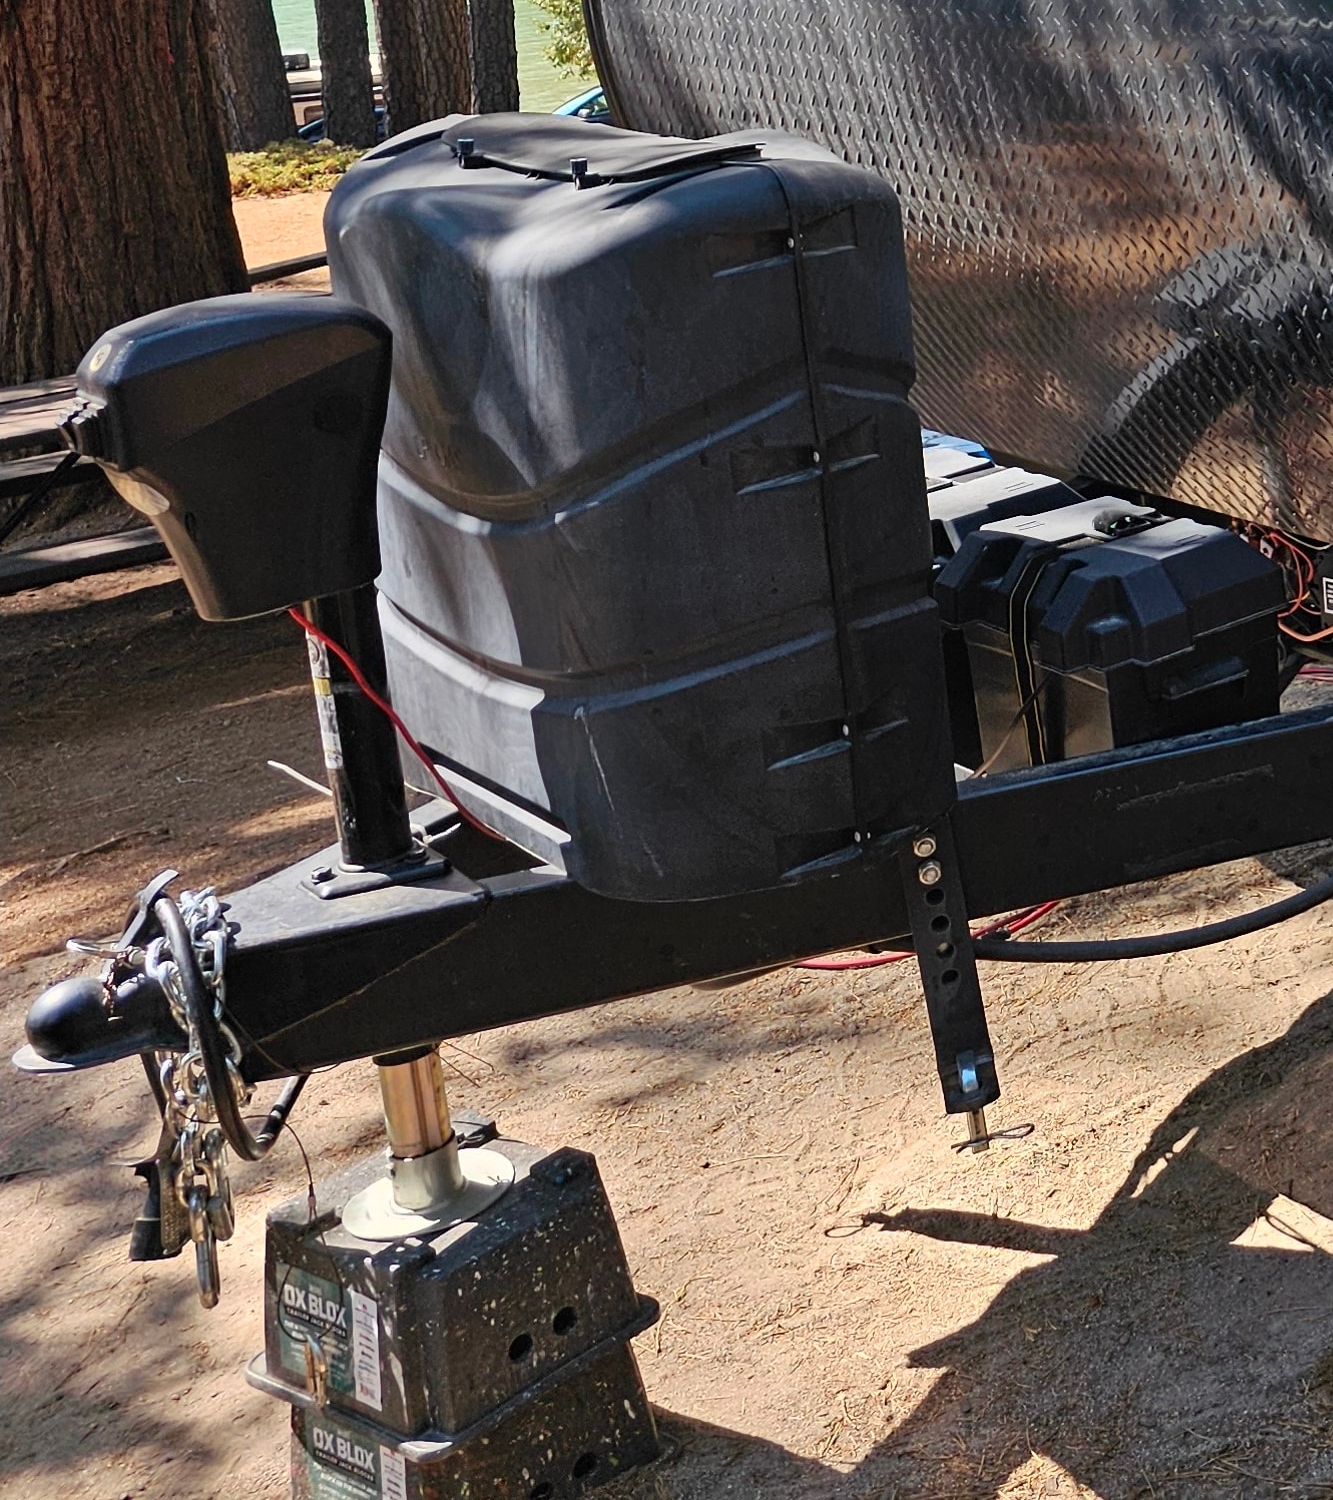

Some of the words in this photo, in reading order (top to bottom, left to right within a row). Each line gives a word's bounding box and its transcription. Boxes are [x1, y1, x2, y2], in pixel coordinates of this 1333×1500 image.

[284, 1283, 307, 1311] OX
[308, 1292, 347, 1328] BLOX
[313, 1426, 335, 1453] OX
[336, 1437, 376, 1473] BLOX
